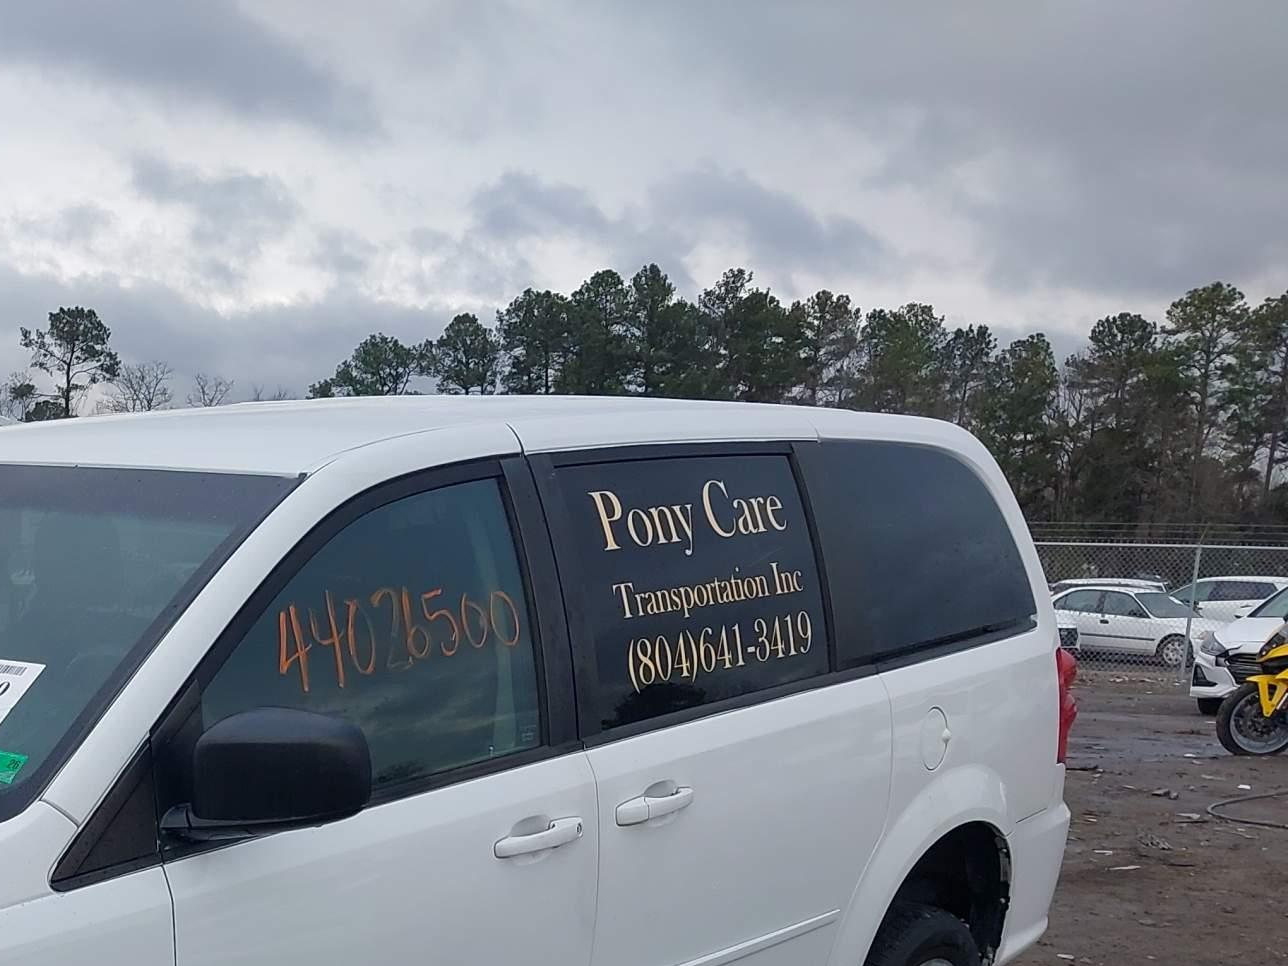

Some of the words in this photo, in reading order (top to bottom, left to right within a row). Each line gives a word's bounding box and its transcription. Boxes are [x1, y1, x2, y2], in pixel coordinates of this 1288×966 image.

[587, 489, 694, 556] Pony
[701, 479, 788, 539] Care
[612, 566, 768, 620] Transportation
[774, 562, 805, 595] Inc
[278, 585, 520, 692] 44026500
[626, 608, 814, 694] (804)641-3419
